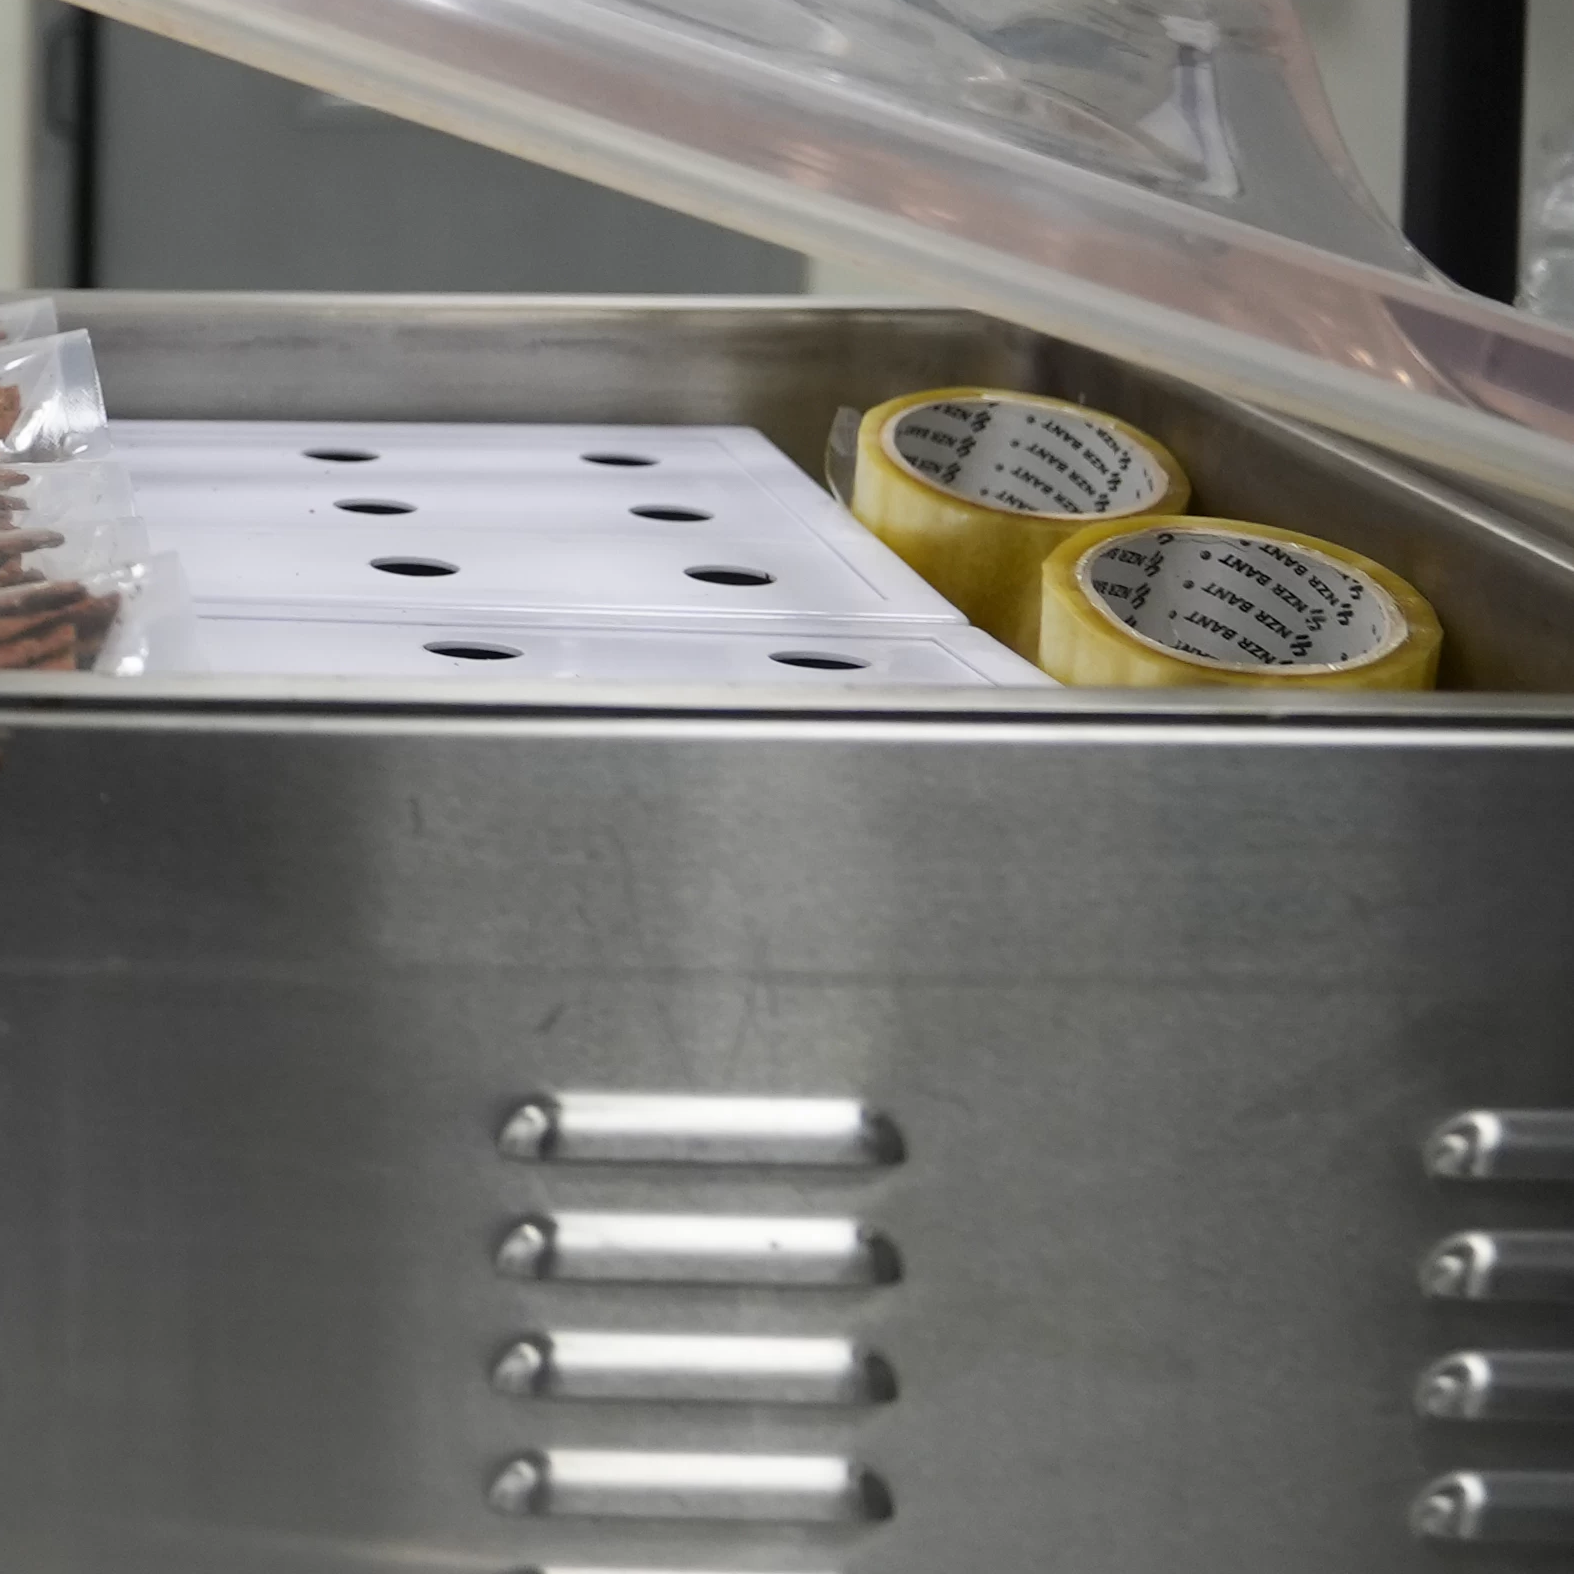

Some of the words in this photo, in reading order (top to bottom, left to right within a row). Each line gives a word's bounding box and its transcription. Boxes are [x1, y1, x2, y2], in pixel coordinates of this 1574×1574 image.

[1041, 419, 1083, 450] BANT
[1026, 442, 1069, 473] BANT
[1083, 448, 1109, 475] NZR
[1010, 467, 1053, 495] BANT
[1068, 469, 1097, 496] NZR
[1218, 553, 1272, 587] BANT
[1259, 543, 1308, 576] BANT
[1200, 582, 1255, 614] BANT
[1272, 582, 1309, 614] NZR
[1308, 574, 1341, 607] NZR
[1183, 610, 1238, 641] BANT
[1254, 609, 1293, 640] NZR
[1237, 636, 1278, 665] NZR
